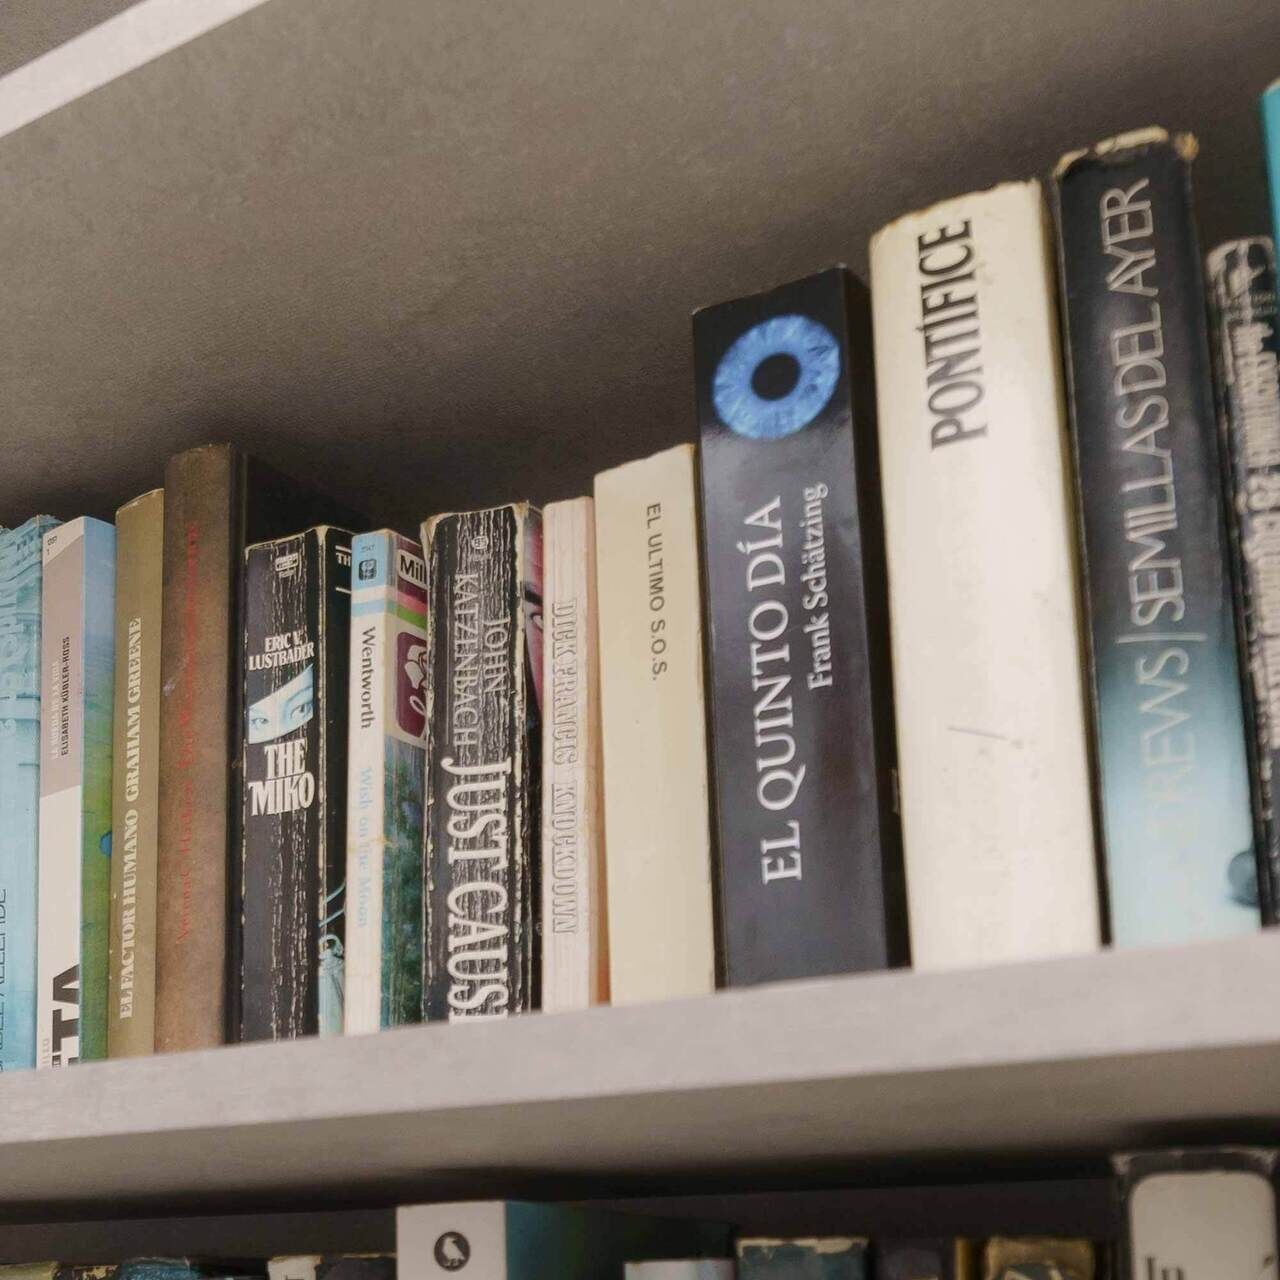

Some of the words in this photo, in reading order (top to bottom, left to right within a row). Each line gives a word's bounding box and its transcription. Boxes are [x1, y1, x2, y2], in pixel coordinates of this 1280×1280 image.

[1099, 177, 1160, 298] AYER
[645, 502, 662, 529] EL
[736, 495, 787, 593] DÍA
[798, 482, 830, 611] Schätzing
[647, 535, 666, 613] ULTIMO
[128, 616, 142, 704] GREENE
[248, 641, 315, 672] LUSTBADER
[265, 633, 293, 653] ERIC
[361, 625, 377, 730] Wentworth
[451, 573, 480, 747] KATZENBACH
[483, 617, 511, 696] JOHN
[803, 613, 834, 690] Frank
[748, 600, 807, 812] QUINTO
[124, 705, 141, 801] GRAHAM
[248, 771, 315, 817] MIKO
[264, 738, 308, 780] THE
[123, 808, 140, 906] HUMANO
[441, 756, 513, 871] JUST
[551, 779, 578, 936] KNOCKDOWN
[761, 819, 803, 885] EL
[121, 906, 136, 990] FACTOR
[120, 990, 133, 1019] EL
